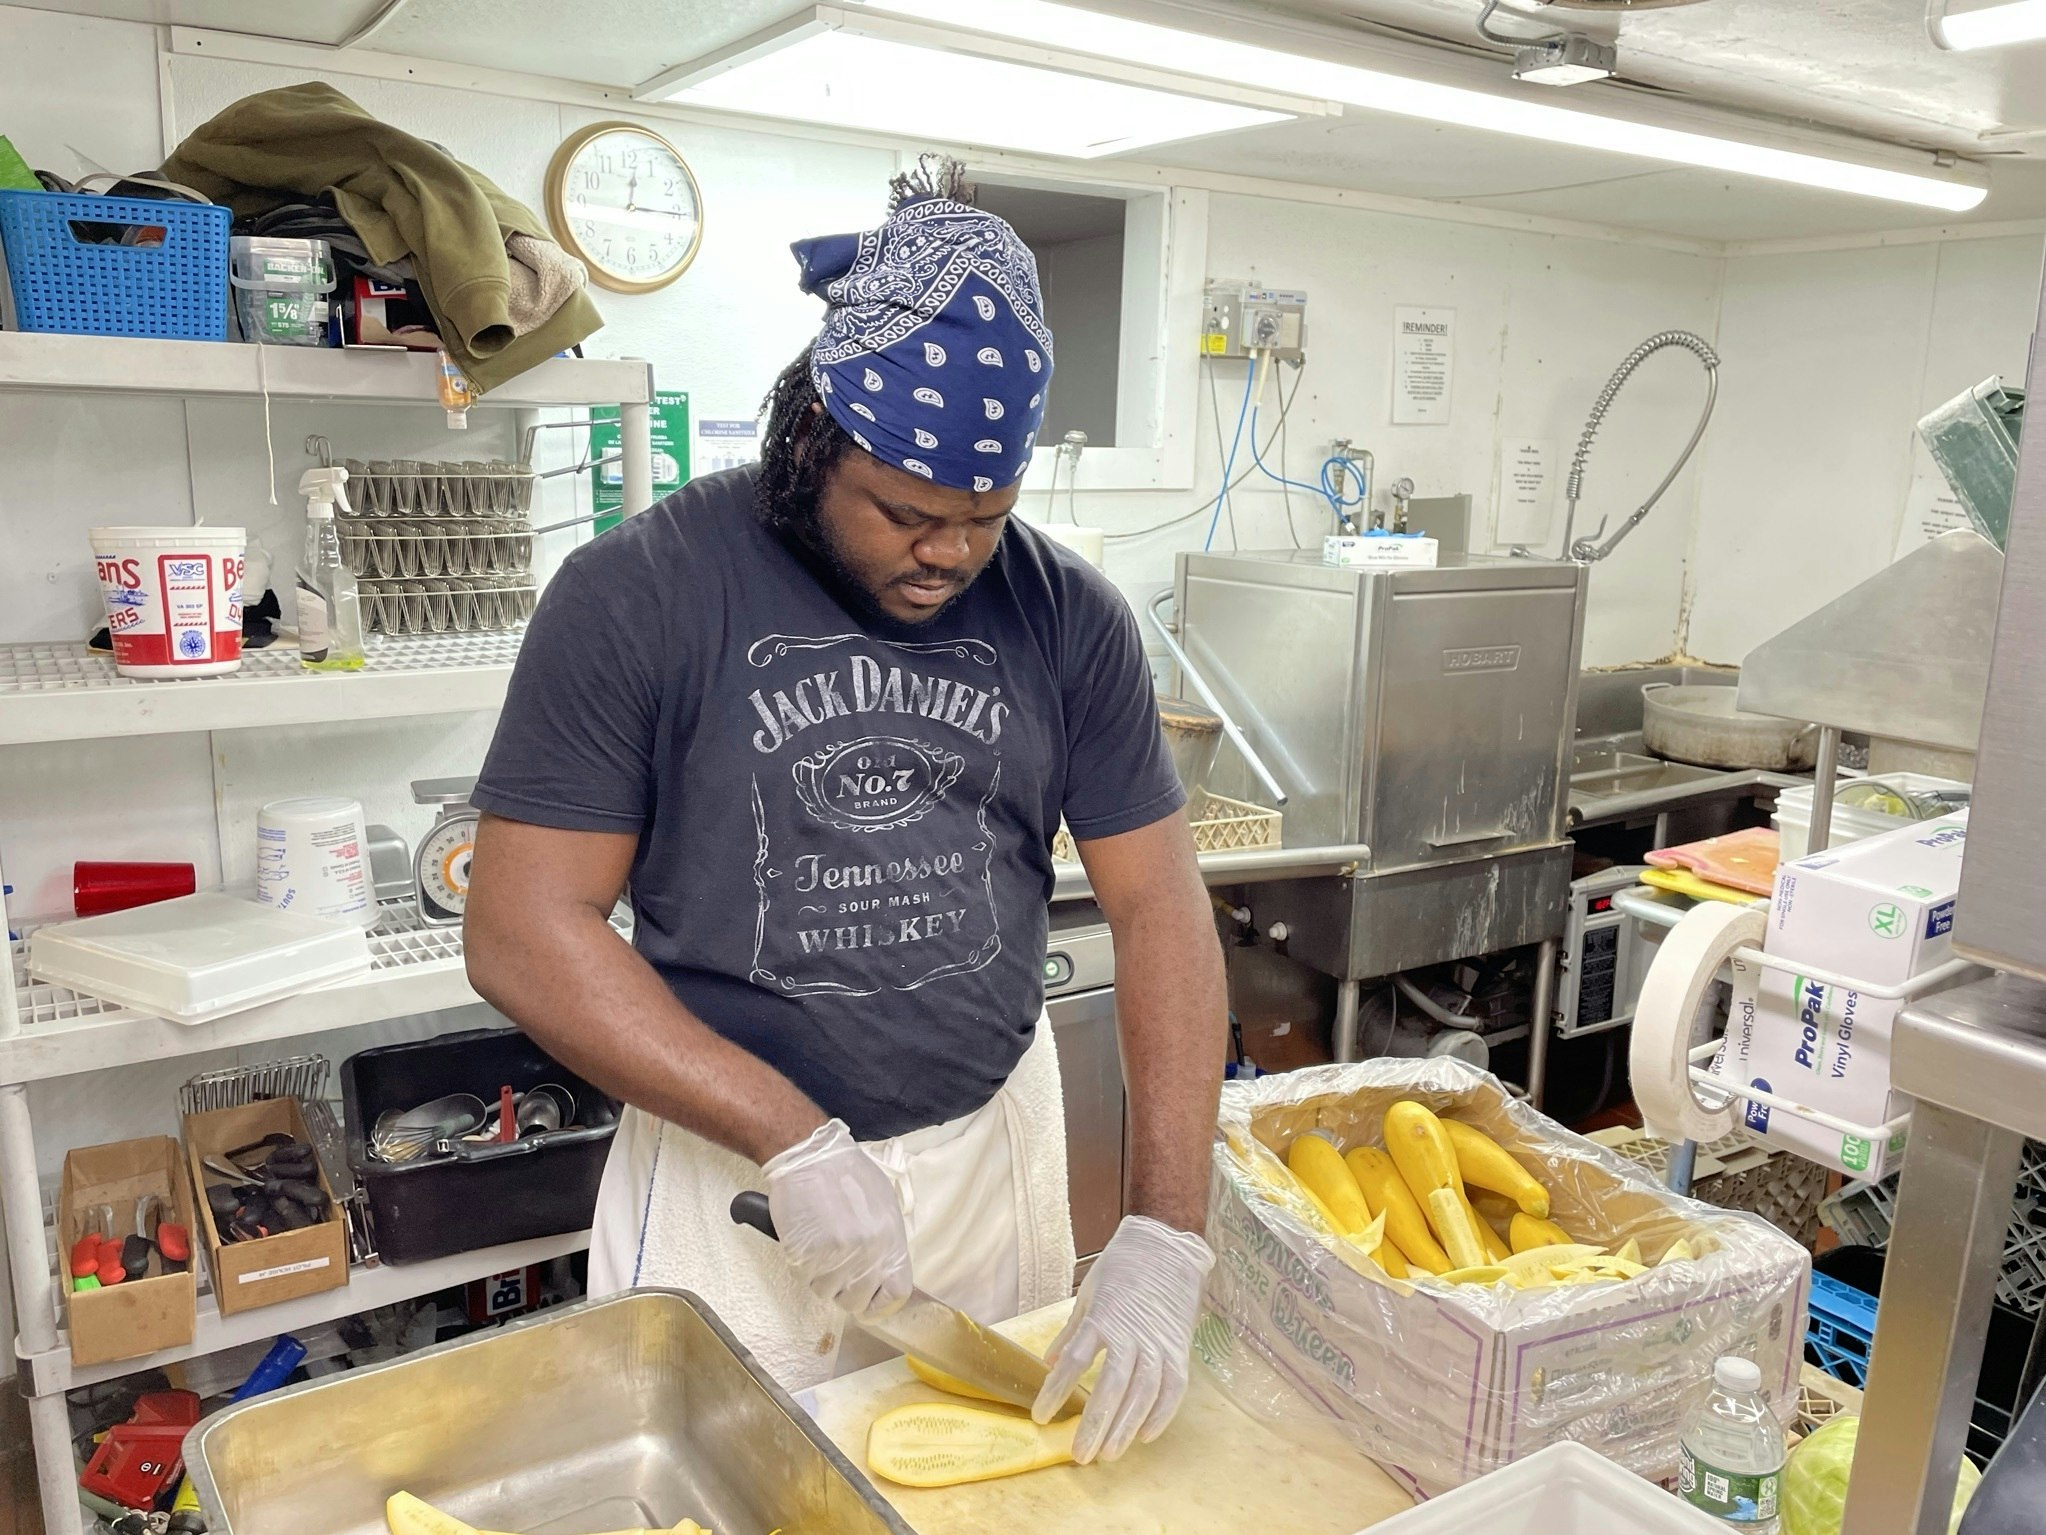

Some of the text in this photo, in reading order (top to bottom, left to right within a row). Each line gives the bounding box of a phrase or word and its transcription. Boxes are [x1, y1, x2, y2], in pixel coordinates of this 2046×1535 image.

[601, 155, 612, 174] 11
[622, 150, 637, 169] 12
[648, 159, 654, 178] 1
[584, 171, 600, 190] 10
[663, 179, 674, 197] 2
[584, 219, 596, 238] 8
[602, 238, 613, 257] 7
[663, 232, 675, 245] 4
[626, 246, 636, 265] 6
[649, 243, 658, 262] 5
[748, 655, 1010, 754] JACK DANIEL'S
[854, 796, 898, 810] BRAND
[1915, 829, 1967, 848] ProPa
[794, 850, 965, 892] Tennessee
[838, 891, 931, 914] SOUR MASH
[1874, 905, 1897, 934] XL
[797, 908, 967, 955] WHISKEY
[1794, 979, 1825, 1070] ProPak
[1831, 990, 1859, 1078] Vinyl Gloves
